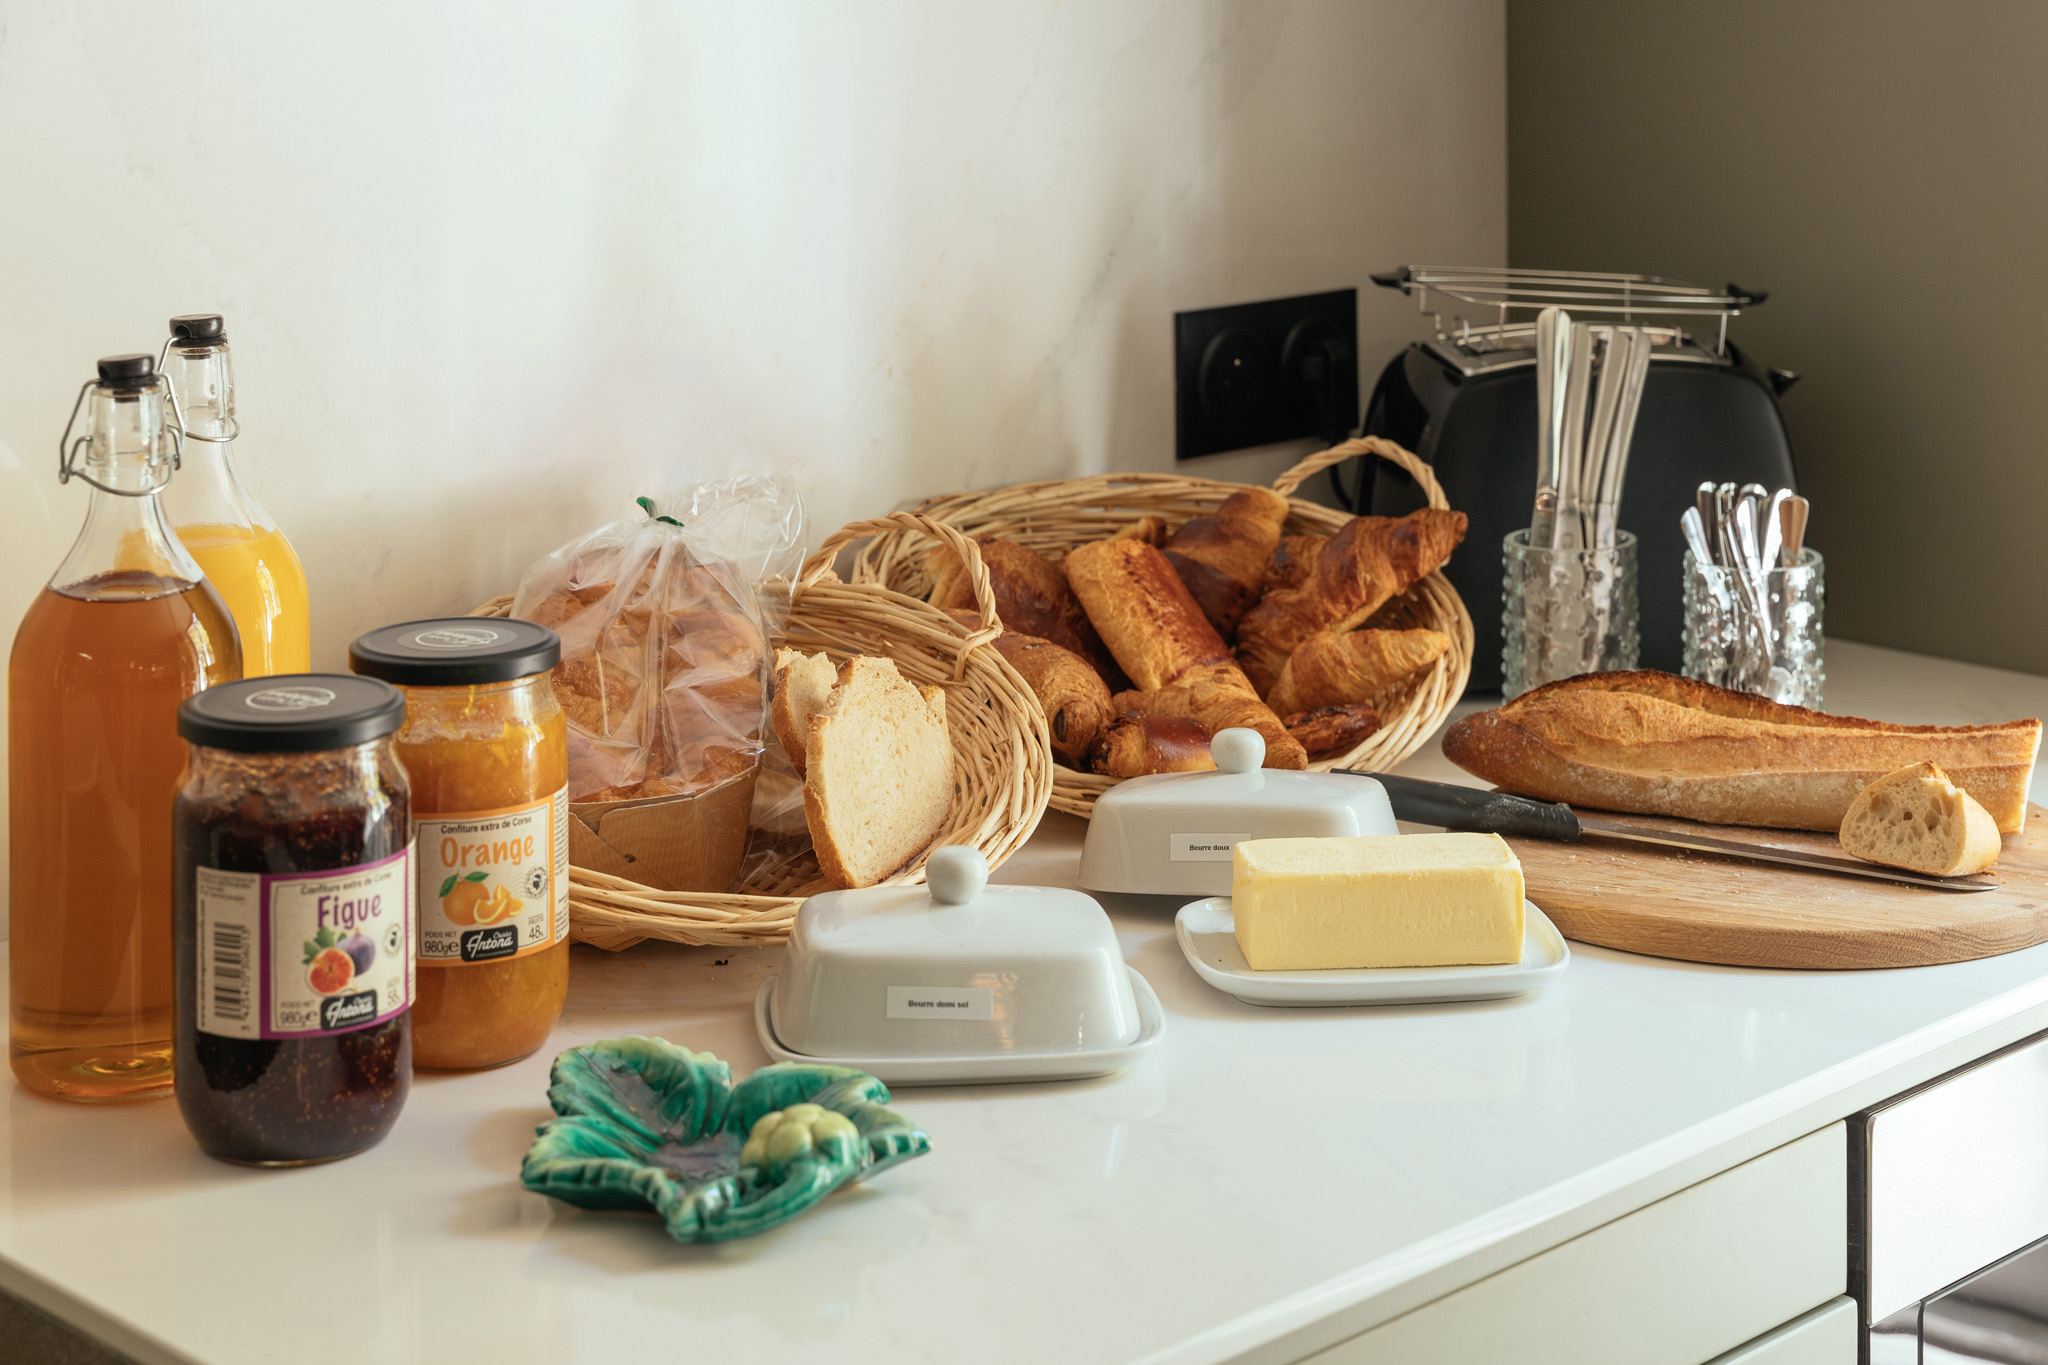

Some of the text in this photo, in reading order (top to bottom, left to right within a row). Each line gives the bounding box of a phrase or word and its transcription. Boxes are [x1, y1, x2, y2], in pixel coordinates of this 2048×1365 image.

[441, 816, 532, 834] Confiture extra de Corse
[440, 835, 535, 868] Orange
[317, 894, 382, 930] Figue
[466, 931, 514, 959] Antona
[325, 997, 375, 1029] Antona
[908, 1000, 935, 1008] Beurre
[936, 1000, 956, 1008] demi
